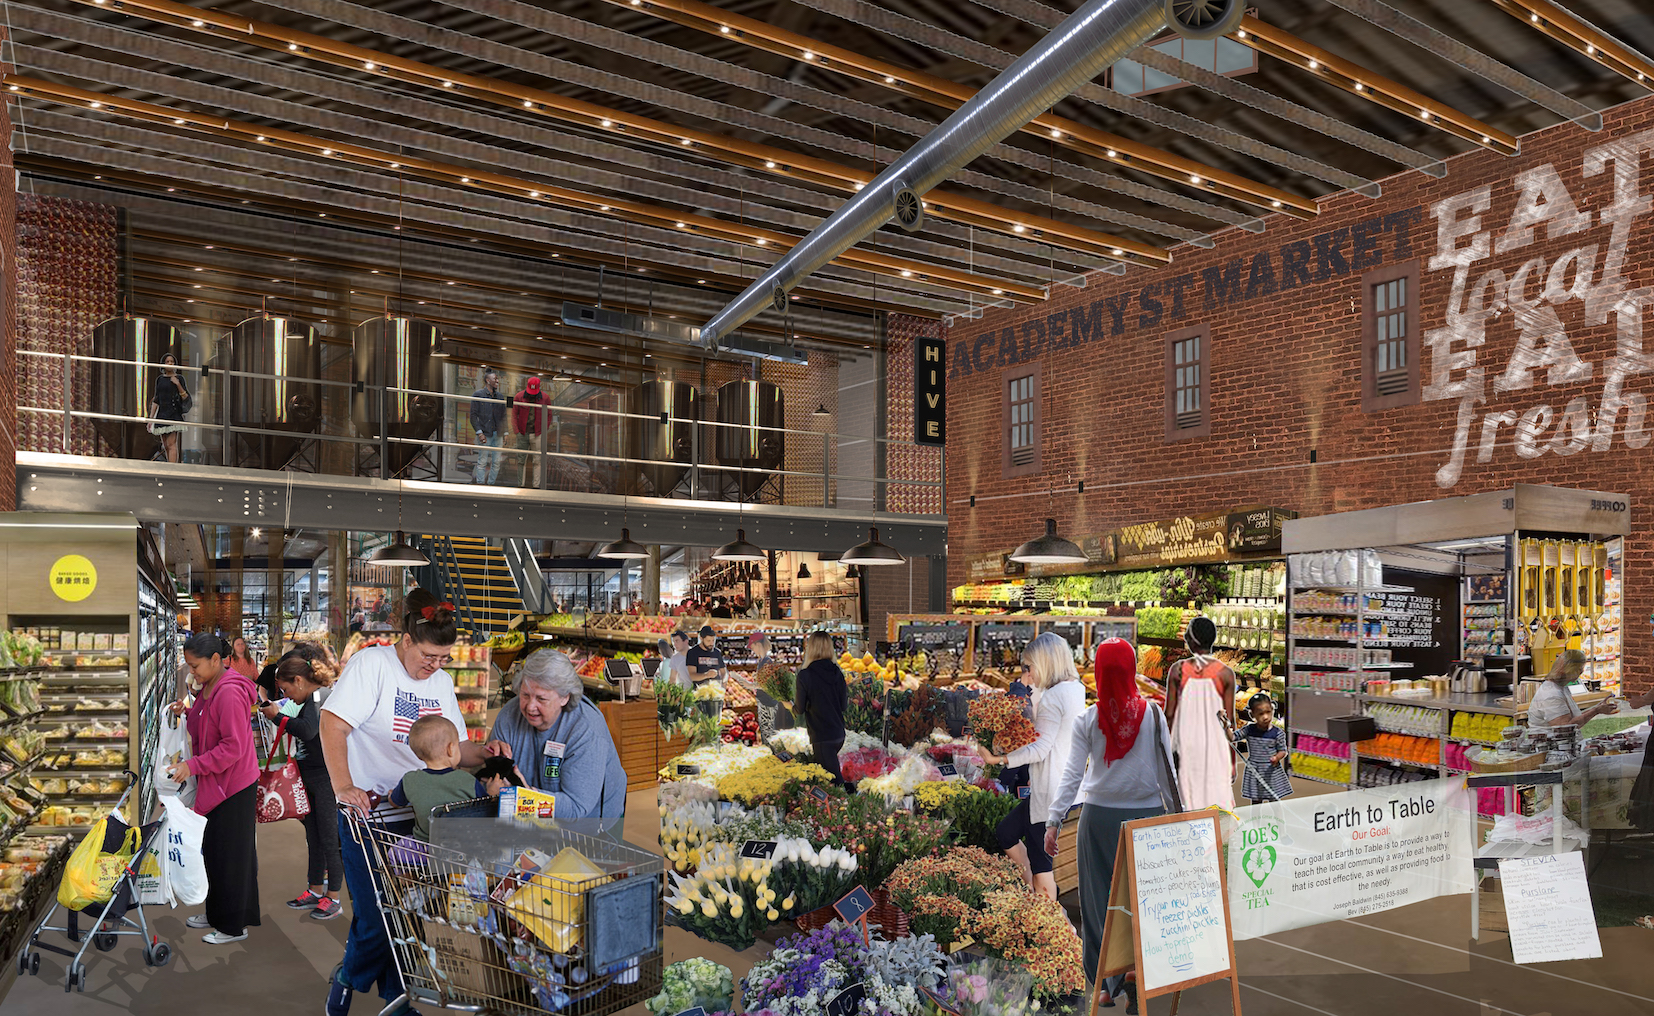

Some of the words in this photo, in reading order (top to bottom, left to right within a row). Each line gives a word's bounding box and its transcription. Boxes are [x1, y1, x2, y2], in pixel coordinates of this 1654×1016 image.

[1428, 130, 1654, 272] EAT
[1446, 216, 1636, 326] local
[947, 291, 1132, 380] ACADEMY
[1138, 272, 1196, 330] ST
[1202, 205, 1423, 310] MARKET
[1422, 286, 1654, 402] EAT
[925, 345, 939, 437] HIVE
[1435, 368, 1652, 489] fresh
[1314, 806, 1361, 832] Earth
[1367, 804, 1383, 824] to
[1389, 795, 1435, 820] Table
[1133, 830, 1152, 842] Earth
[1153, 828, 1162, 839] To
[1162, 827, 1182, 838] Table
[1240, 822, 1279, 851] JOE'S
[1352, 830, 1367, 841] Our
[1370, 826, 1391, 838] Goal:
[751, 843, 767, 856] 12
[1294, 856, 1306, 867] Our
[1308, 853, 1324, 866] goal
[1326, 852, 1334, 860] at
[1335, 849, 1354, 859] Earth
[1355, 847, 1362, 855] to
[1364, 843, 1383, 854] Table
[1384, 841, 1390, 850] is
[1392, 840, 1398, 848] to
[1400, 834, 1424, 847] provide
[1430, 832, 1443, 843] way
[1294, 868, 1314, 879] teach
[1316, 864, 1328, 874] the
[1329, 862, 1346, 872] local
[1348, 853, 1384, 870] community
[1386, 854, 1390, 862] a
[1392, 851, 1405, 862] way
[1406, 849, 1413, 858] to
[1414, 846, 1424, 856] eat
[1520, 855, 1557, 866] STEVIA
[1292, 880, 1306, 892] that
[1308, 878, 1314, 888] is
[1316, 876, 1332, 887] cost
[1333, 870, 1364, 885] effective,
[1366, 870, 1374, 878] as
[1375, 864, 1389, 876] well
[1390, 865, 1398, 873] as
[1400, 859, 1429, 871] providing
[1430, 854, 1444, 865] food
[1358, 880, 1370, 891] the
[1370, 876, 1392, 889] needy.
[1521, 886, 1556, 897] Purslane
[1242, 888, 1274, 900] SPECIAL
[850, 897, 865, 912] 8
[1140, 898, 1157, 920] Try
[1171, 894, 1189, 908] new
[1246, 896, 1270, 910] TEA
[1332, 901, 1352, 910] Joseph
[1352, 896, 1372, 907] Baldwin
[1347, 908, 1358, 916] Bev
[1144, 942, 1162, 957] How
[1164, 940, 1174, 950] to
[1168, 951, 1194, 965] demo
